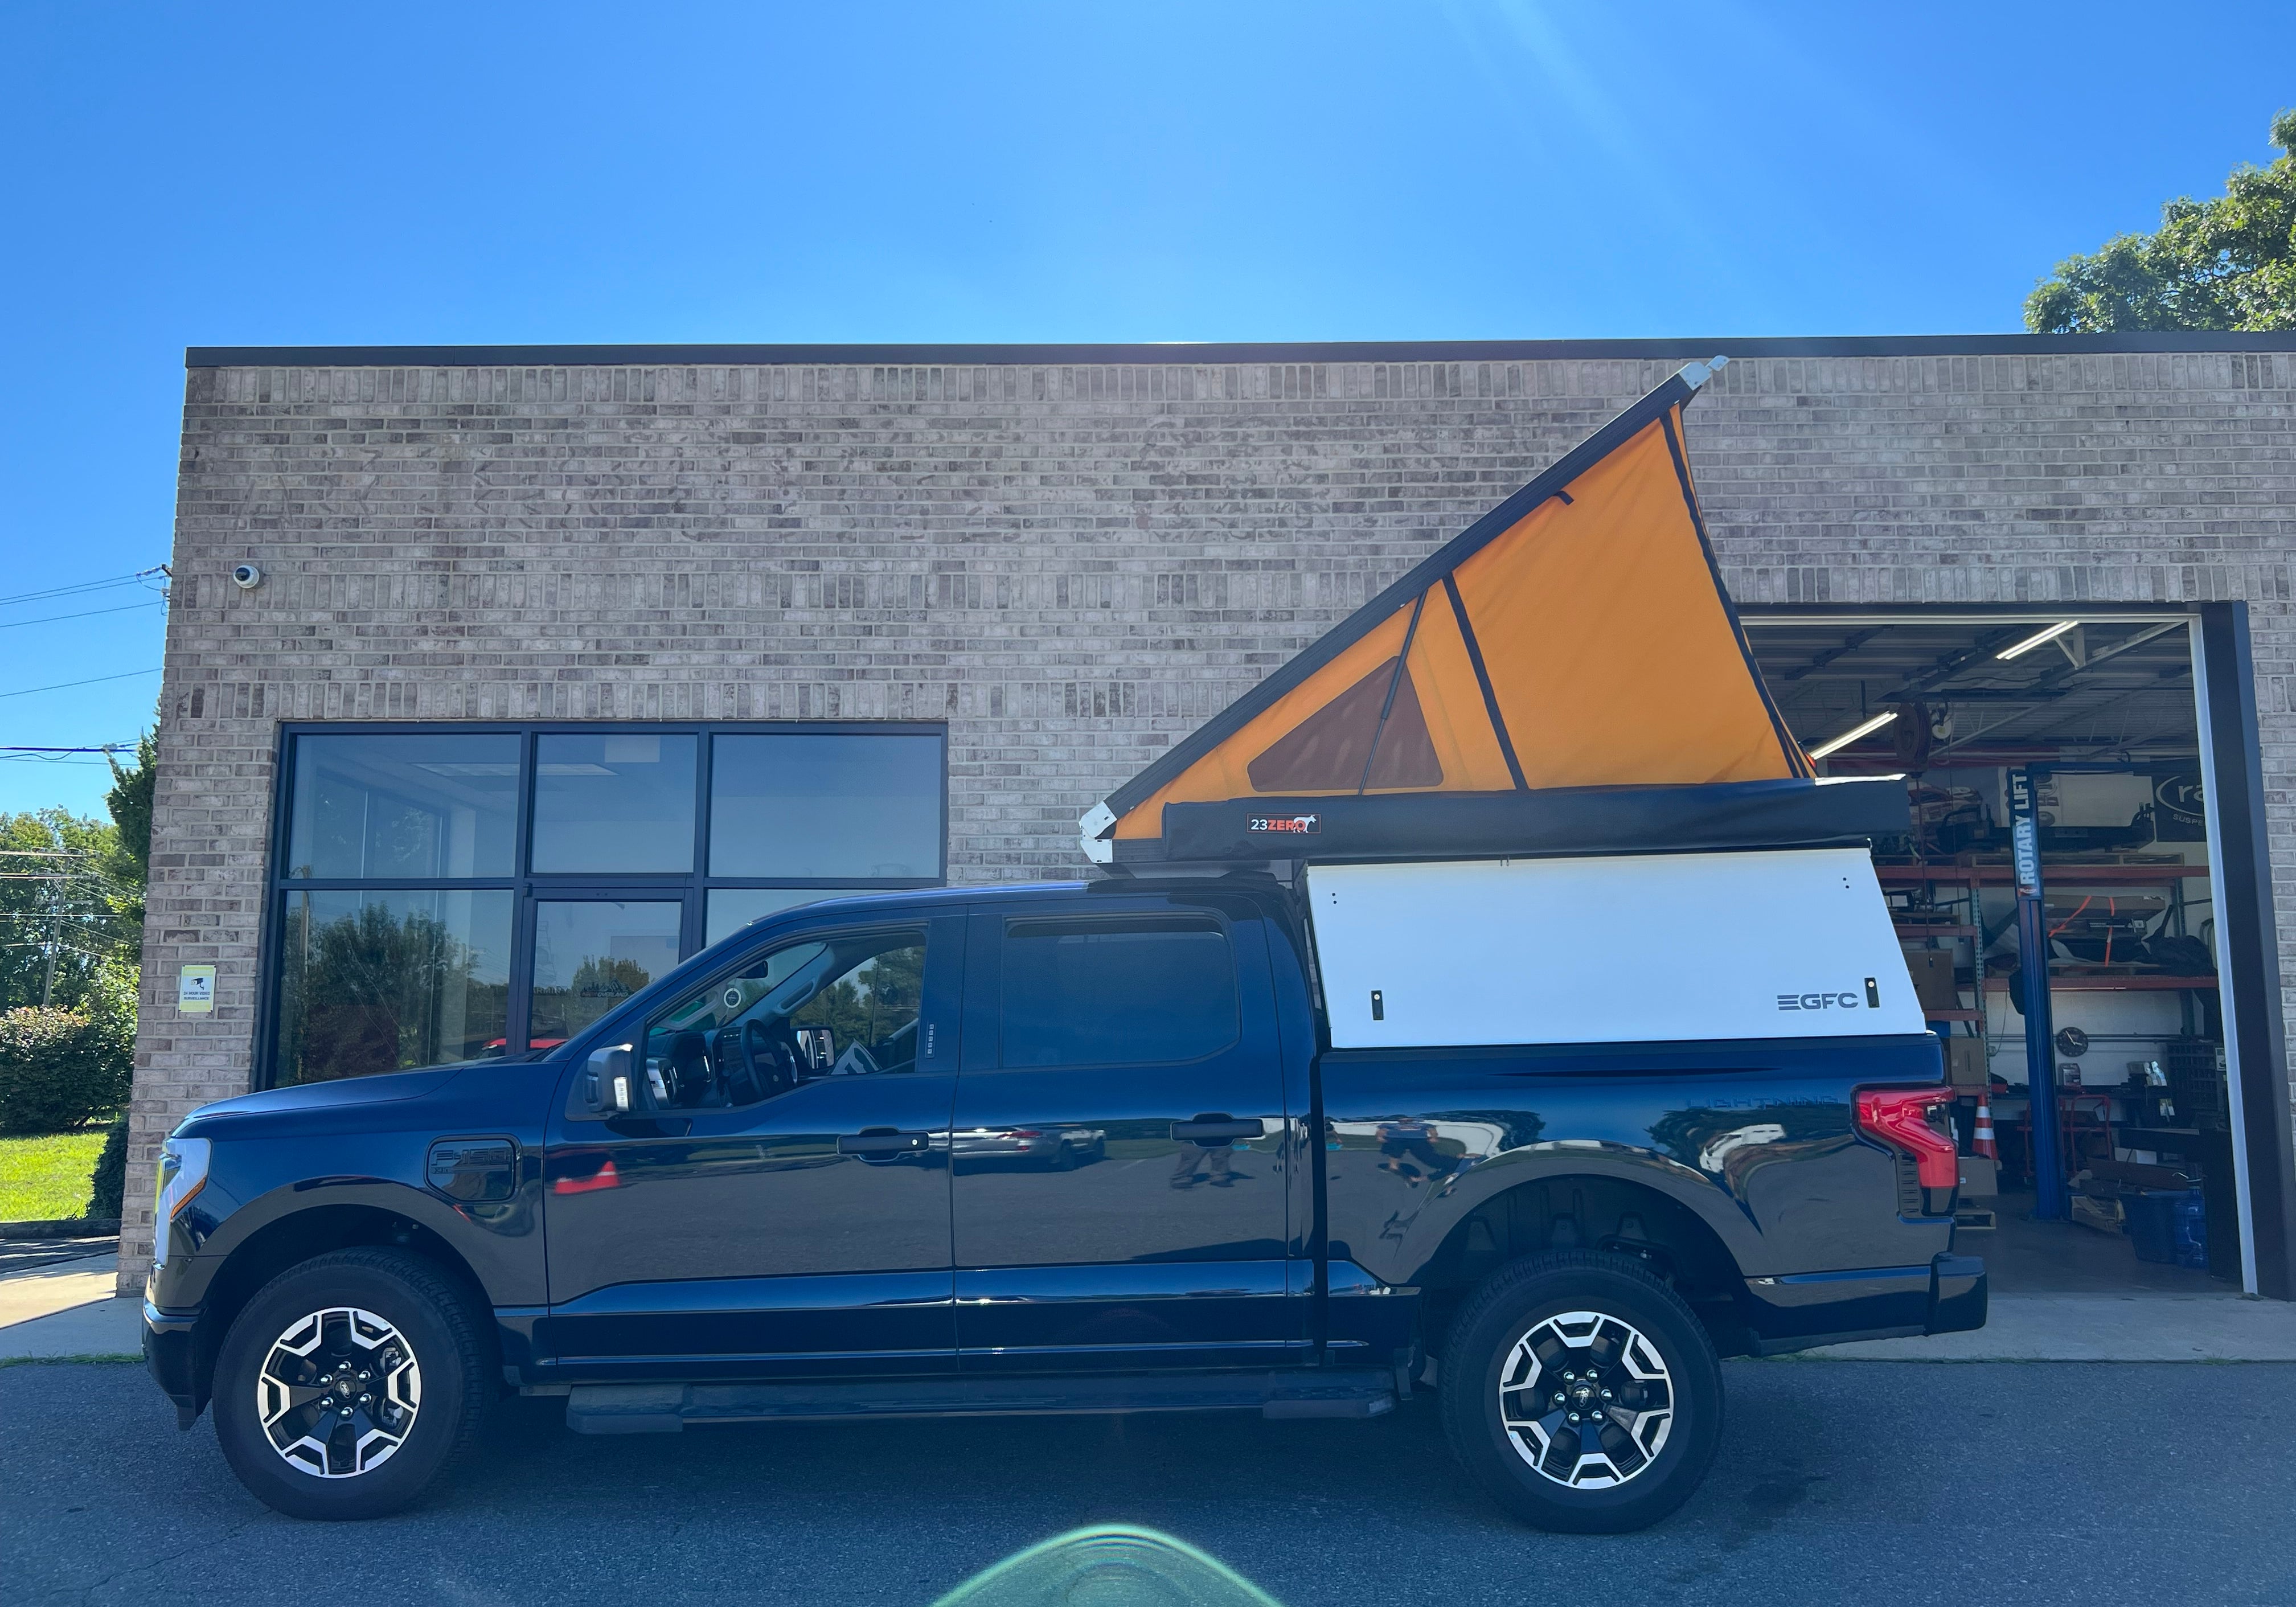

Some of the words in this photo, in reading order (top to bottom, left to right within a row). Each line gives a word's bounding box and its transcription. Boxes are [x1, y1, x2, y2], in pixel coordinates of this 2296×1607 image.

[2012, 774, 2030, 810] LIFT
[1250, 819, 1306, 831] 23ZERO
[2015, 815, 2035, 885] ROTARY
[1686, 1096, 1840, 1109] LIGHTNING
[431, 1147, 511, 1166] F-150
